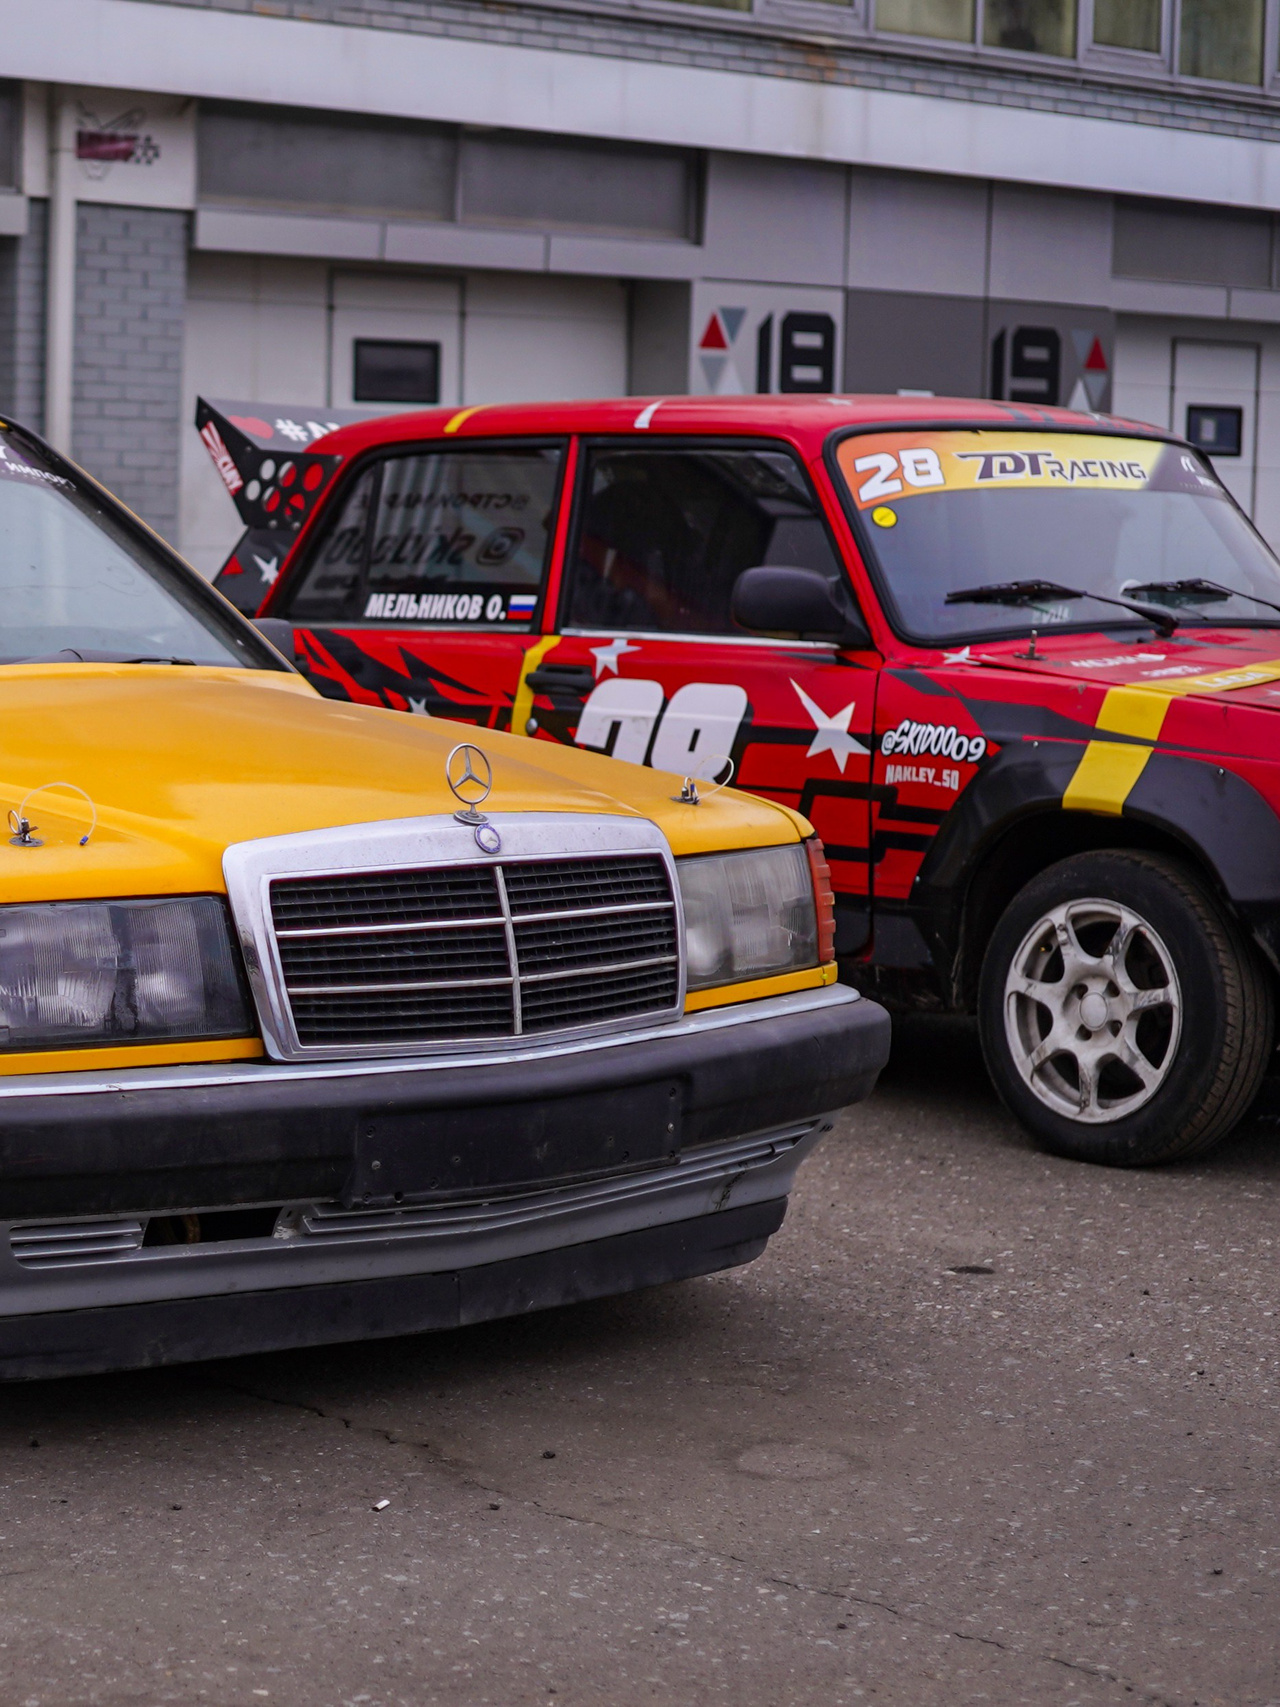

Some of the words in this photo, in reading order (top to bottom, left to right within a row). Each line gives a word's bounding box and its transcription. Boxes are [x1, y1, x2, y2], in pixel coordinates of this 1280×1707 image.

[757, 311, 835, 394] 18
[992, 325, 1061, 405] 19
[854, 447, 945, 502] 28
[365, 593, 483, 619] МЕЛЬНИКОВ
[485, 595, 507, 621] О.
[881, 719, 987, 762] @SKIDOO09
